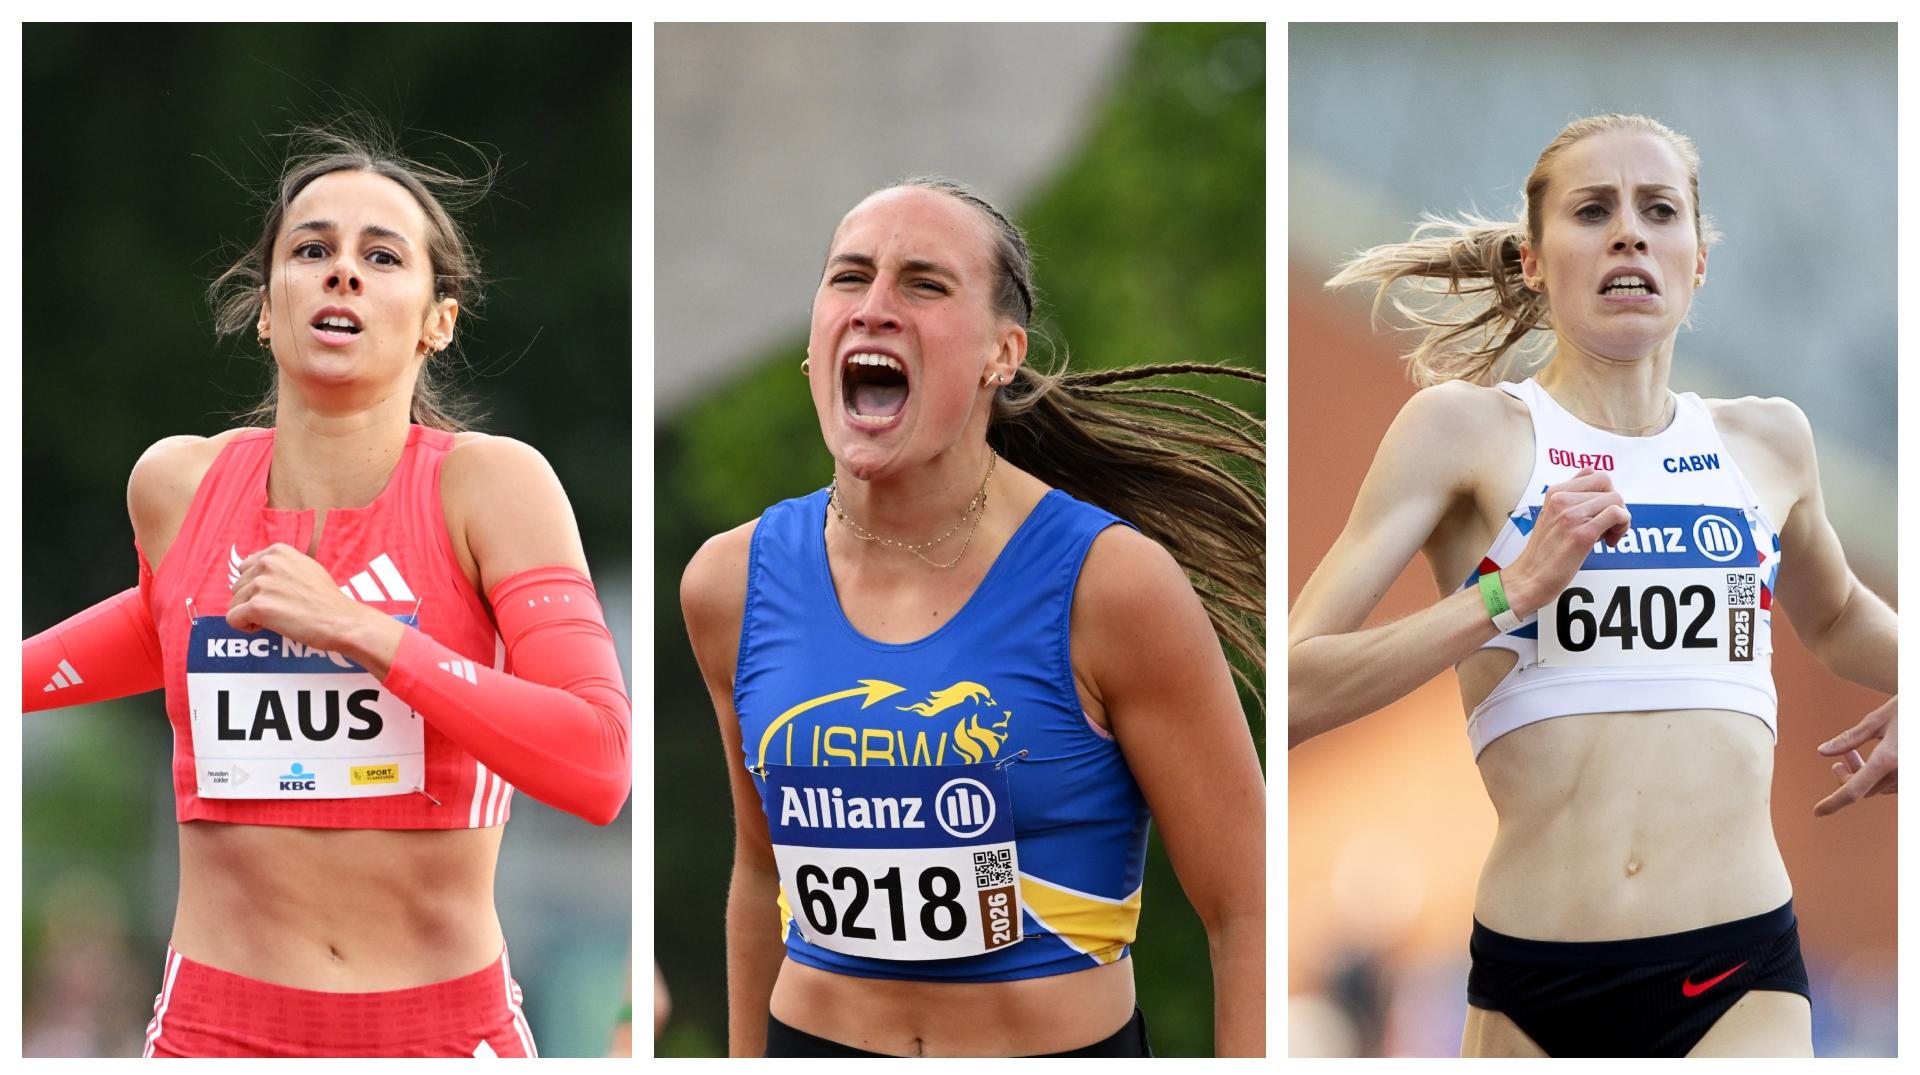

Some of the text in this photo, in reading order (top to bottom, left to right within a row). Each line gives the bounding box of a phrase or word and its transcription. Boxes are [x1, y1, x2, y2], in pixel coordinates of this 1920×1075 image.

[1549, 448, 1614, 471] GOLAZO
[1663, 453, 1720, 473] CABW
[1556, 584, 1718, 652] 6402
[1734, 610, 1750, 658] 2025
[217, 688, 384, 742] LAUS
[280, 780, 316, 791] KBC
[366, 768, 392, 776] SPORT
[780, 786, 925, 829] Allianz
[796, 864, 967, 942] 6218
[987, 892, 1011, 945] 2026
